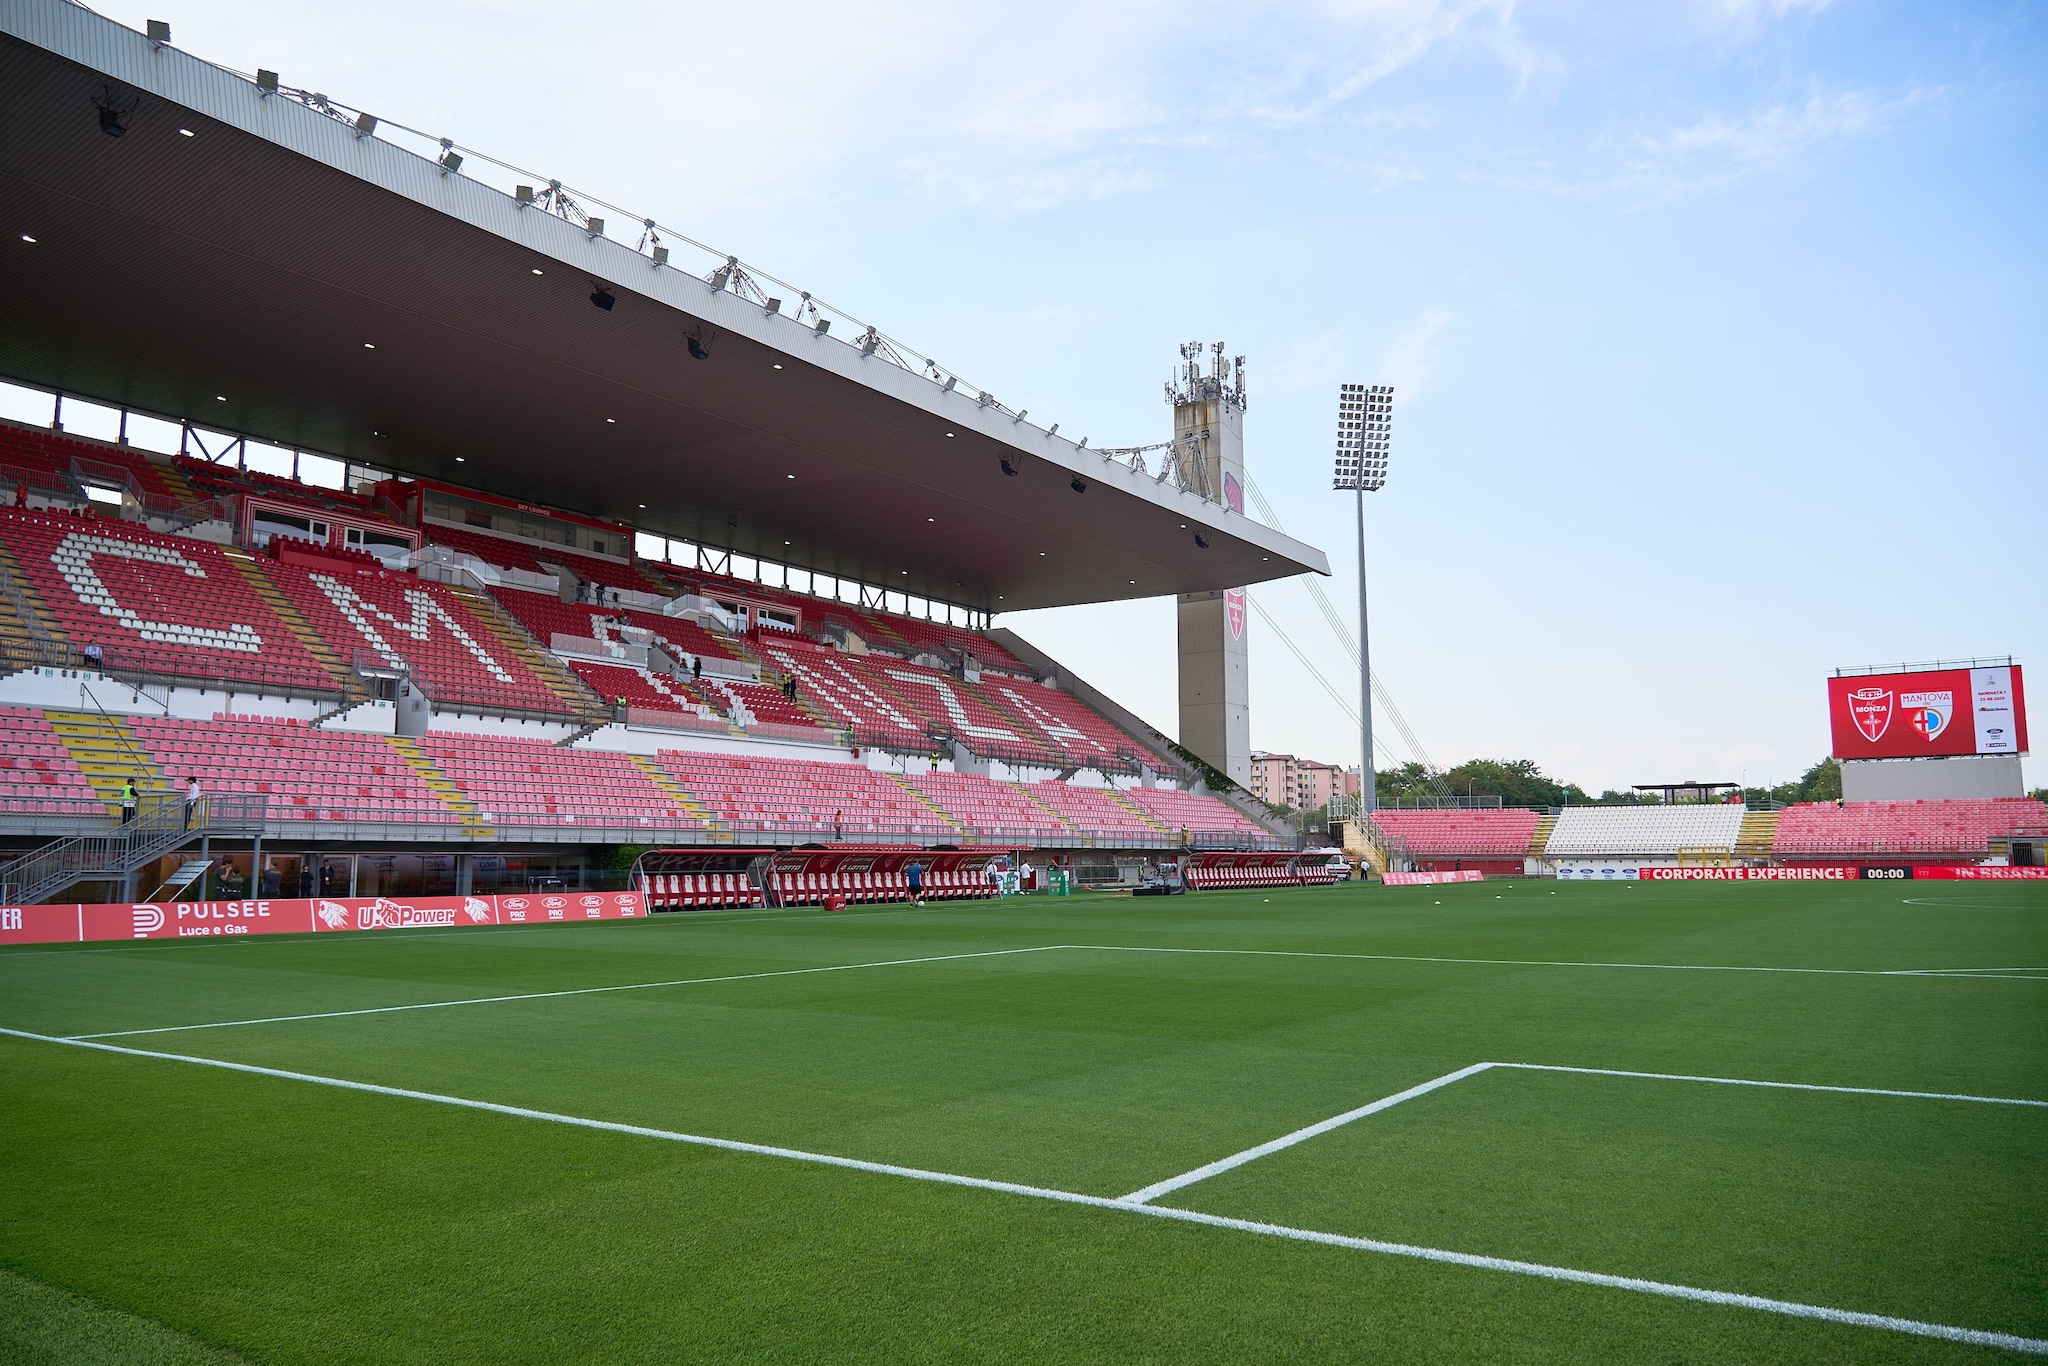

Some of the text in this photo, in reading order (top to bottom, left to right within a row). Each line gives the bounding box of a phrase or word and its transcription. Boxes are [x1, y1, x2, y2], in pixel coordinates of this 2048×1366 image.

[529, 506, 550, 516] LOUNGE
[1902, 692, 1950, 703] MANTOVA
[1652, 868, 1844, 880] CORPORATE EXPERIENCE
[1868, 869, 1904, 878] 00:00
[1956, 868, 1974, 878] IN
[177, 902, 270, 920] PULSEE
[399, 906, 454, 926] Power
[0, 908, 22, 930] ER
[179, 926, 210, 936] Luce
[224, 924, 248, 934] Gas
